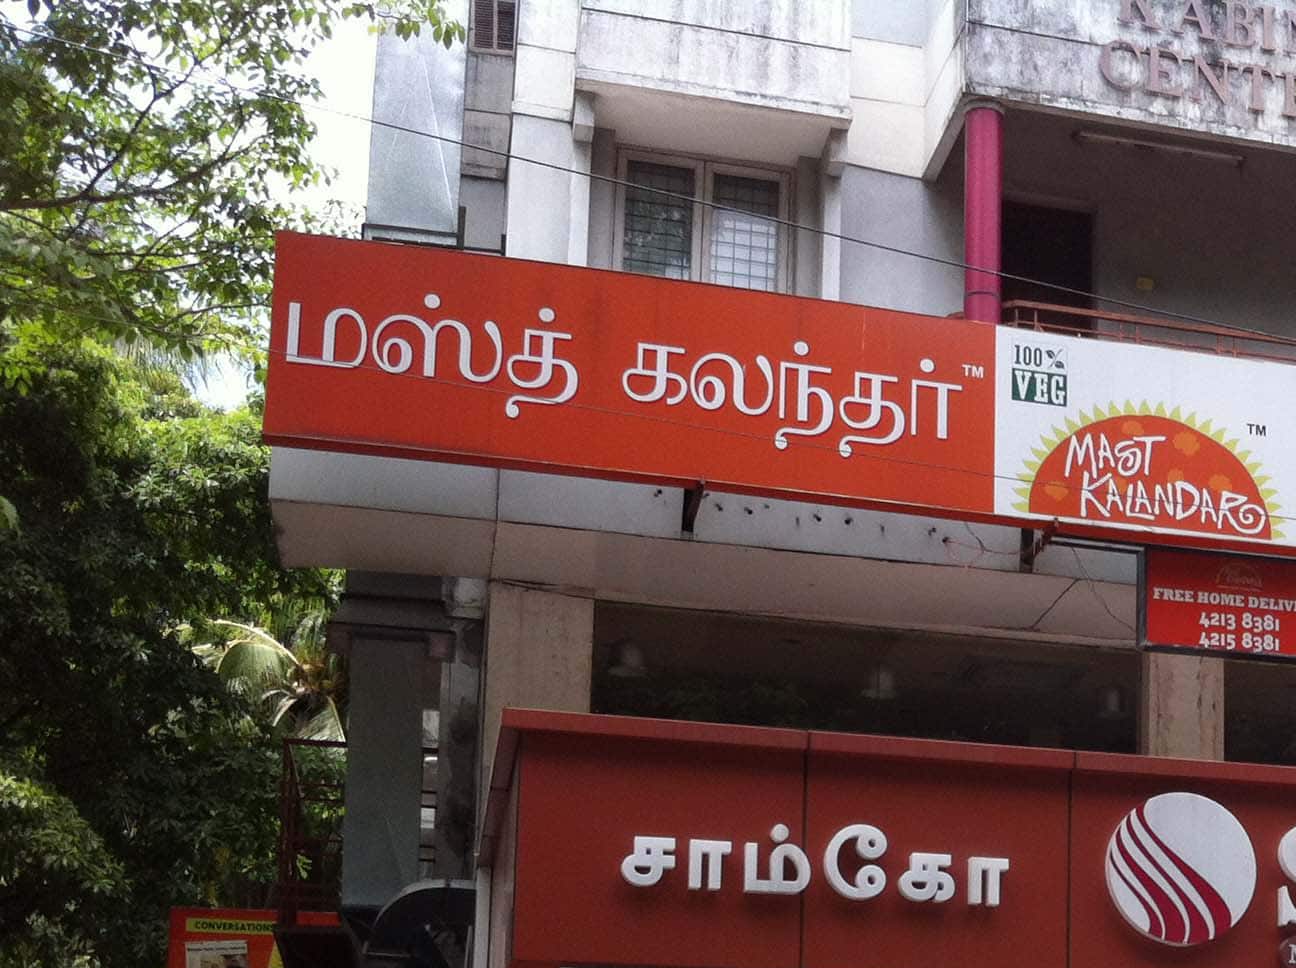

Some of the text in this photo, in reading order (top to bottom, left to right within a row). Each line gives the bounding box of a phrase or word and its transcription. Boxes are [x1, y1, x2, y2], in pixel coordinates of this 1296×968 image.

[286, 294, 963, 458] மஸ்த் கலந்தர்
[1013, 369, 1066, 406] VEG
[1064, 432, 1167, 478] MAST
[1080, 472, 1267, 535] KALANDAR
[1153, 587, 1194, 602] FREE
[1197, 591, 1245, 607] HOME
[1199, 612, 1280, 632] 4213 8381
[1199, 632, 1280, 652] 4215 8381
[620, 823, 1009, 907] சாம்கோ
